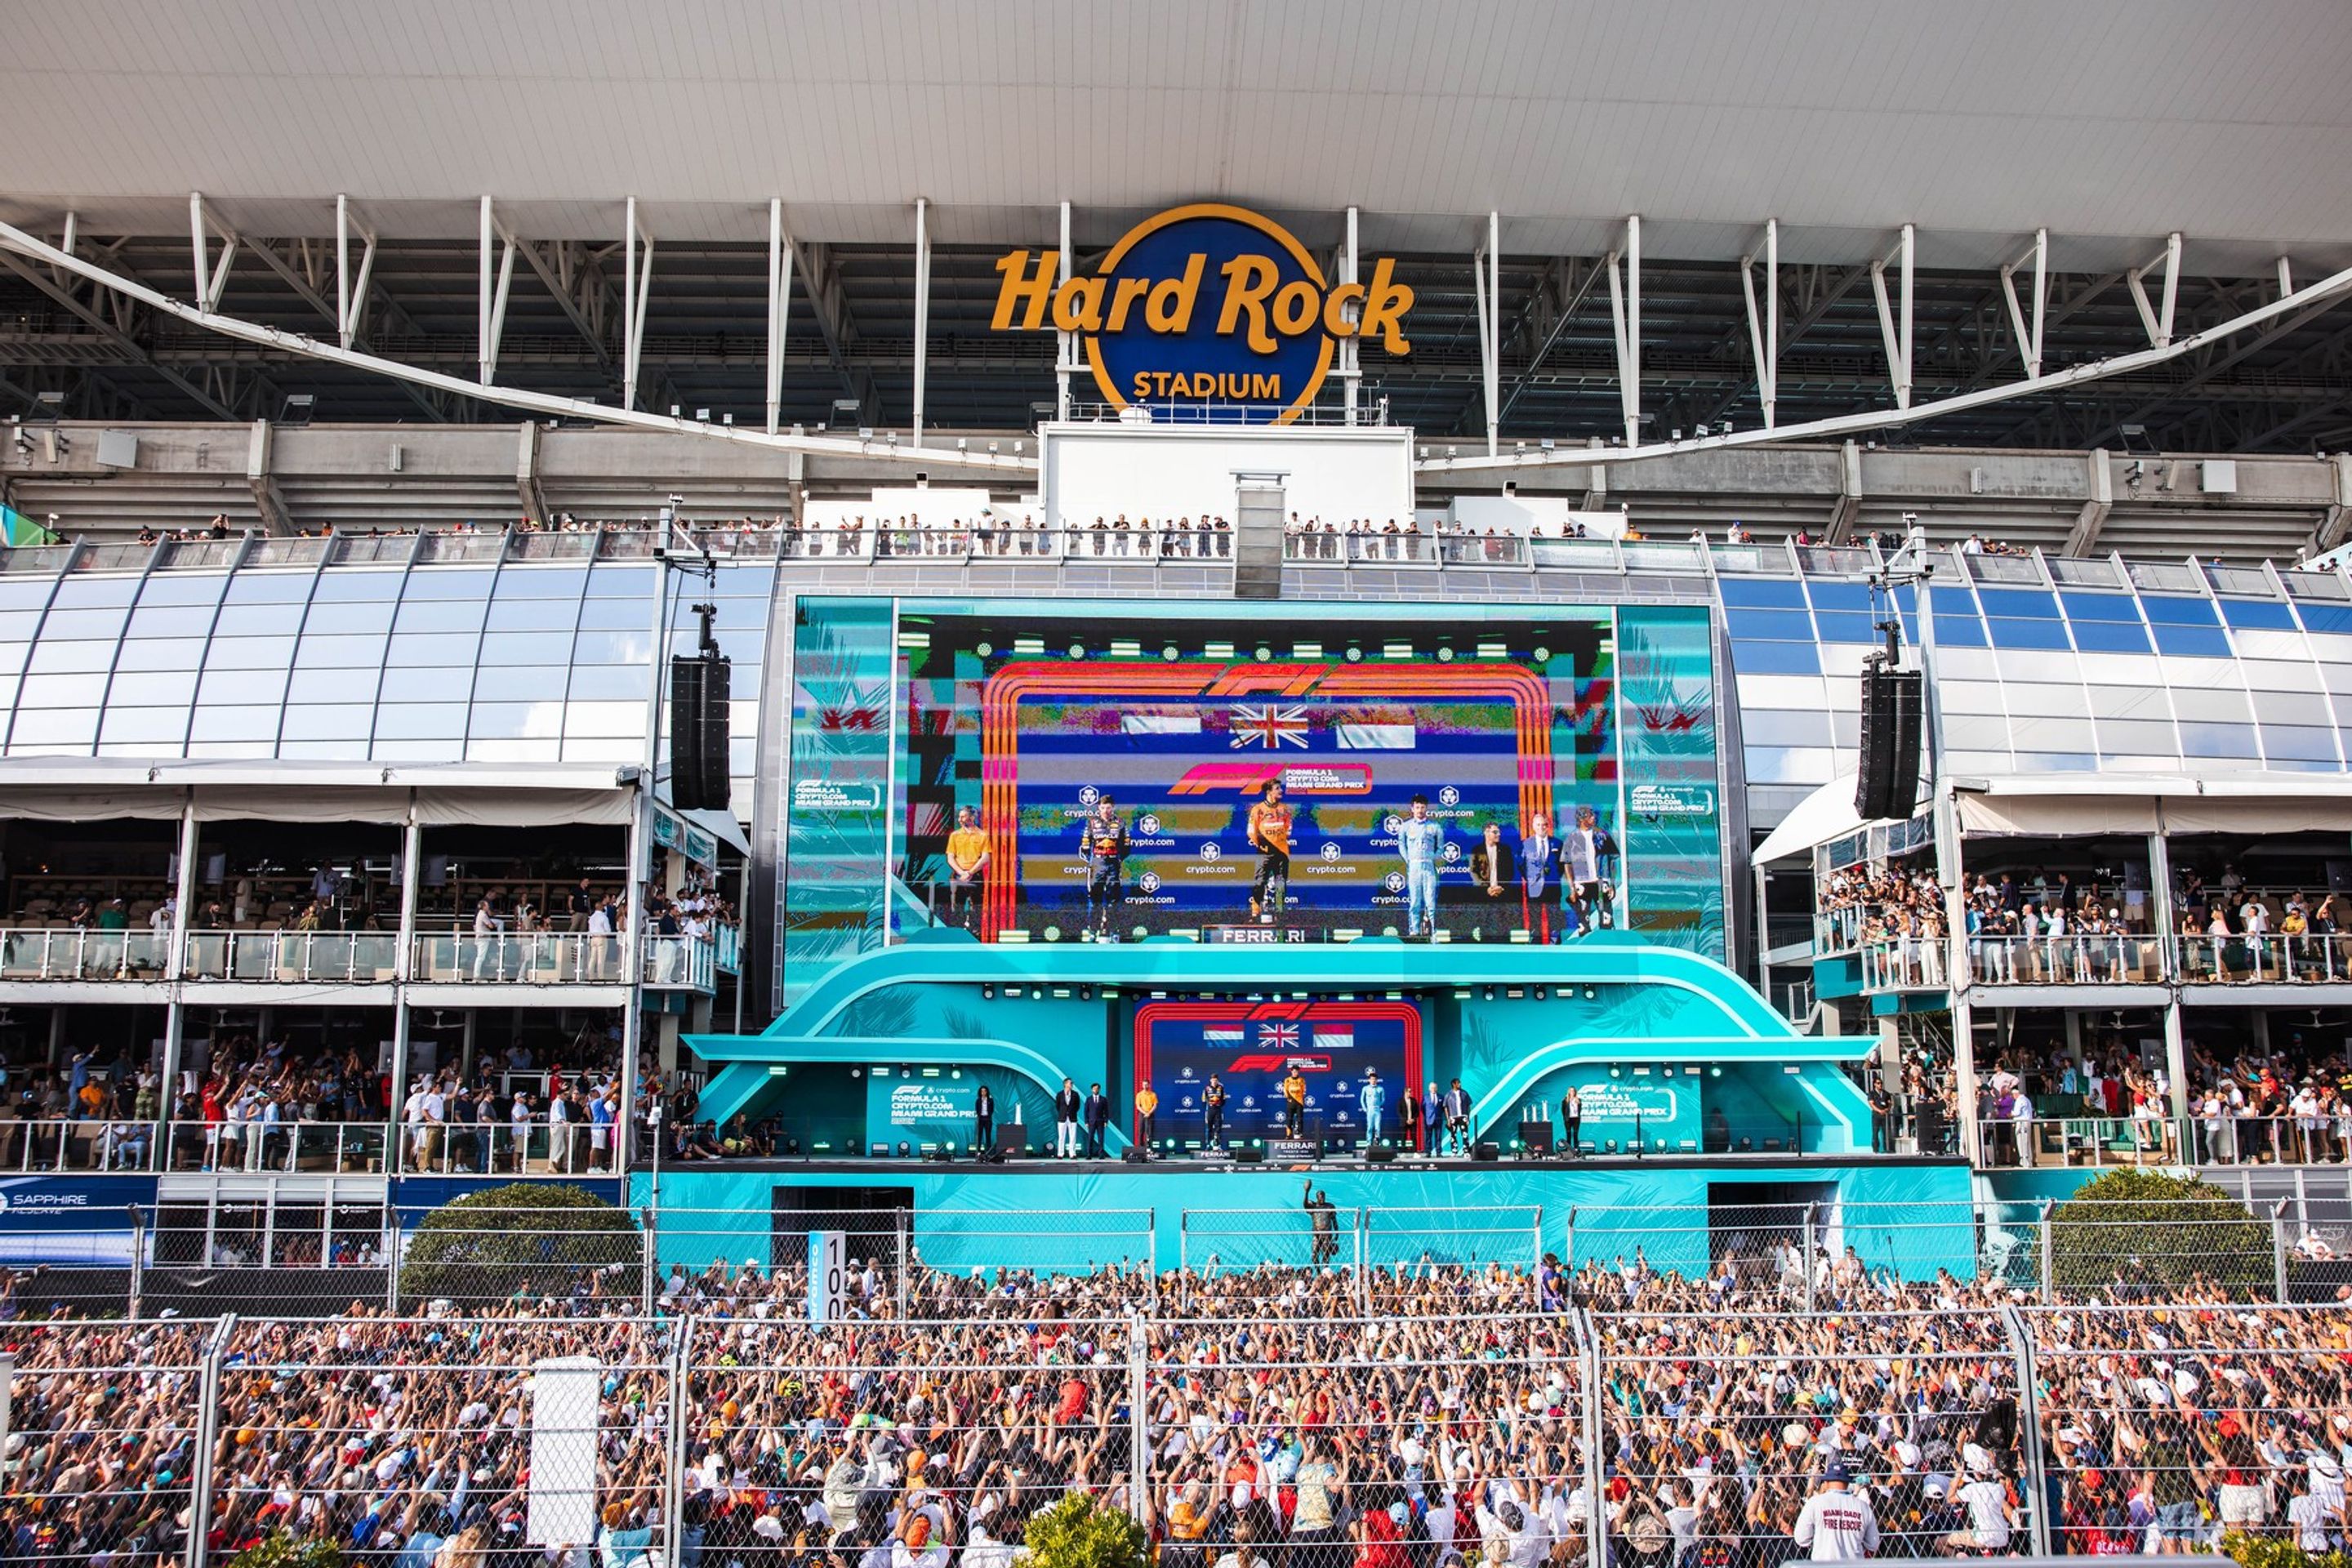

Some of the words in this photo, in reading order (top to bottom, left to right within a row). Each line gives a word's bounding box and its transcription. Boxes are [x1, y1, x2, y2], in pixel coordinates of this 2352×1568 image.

[991, 250, 1207, 335] Hard
[1216, 253, 1414, 356] Rock
[1133, 371, 1281, 400] STADIUM
[1064, 809, 1100, 818] crypto.c
[1425, 810, 1475, 819] crypto.com
[1130, 838, 1175, 847] rypto.com
[1370, 839, 1399, 848] crypto
[1187, 866, 1236, 875] crypto.com
[1307, 866, 1356, 875] crypto.com
[1437, 866, 1471, 875] ypto.co
[1125, 896, 1175, 905] crypto.com
[1274, 1142, 1317, 1150] FERRARI
[12, 1194, 87, 1205] SAPPHIRE
[1824, 1519, 1838, 1529] FIRE
